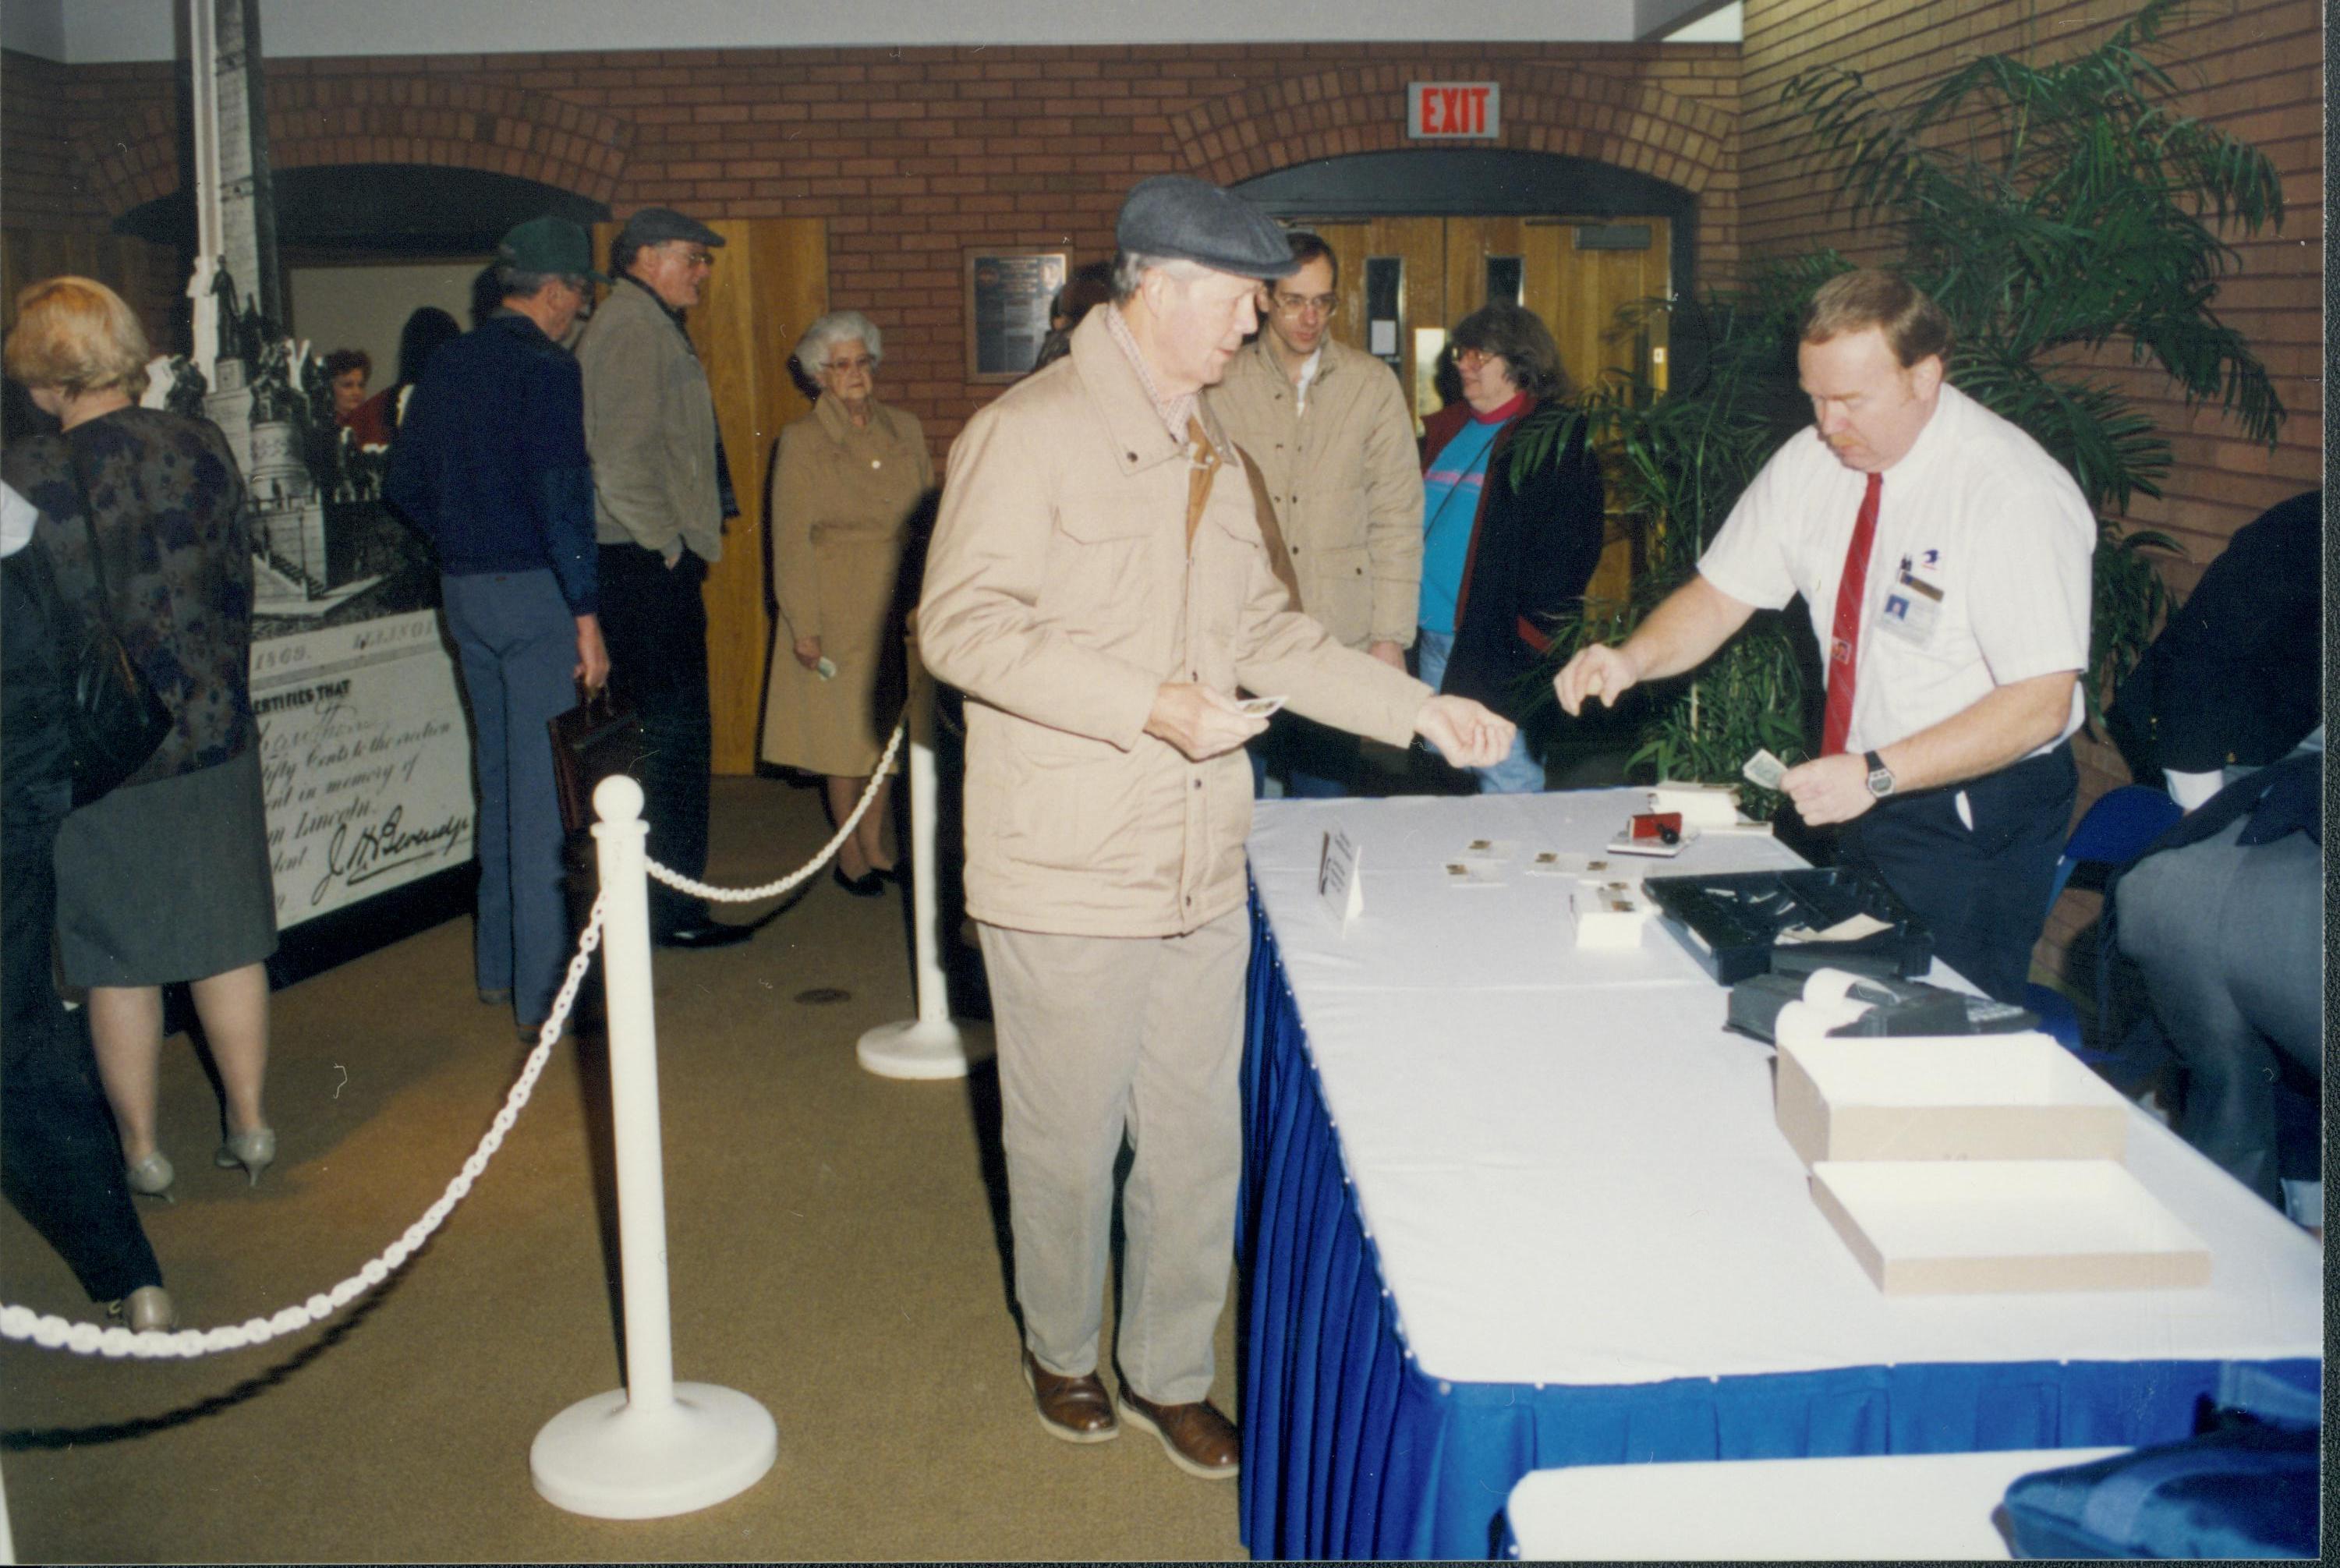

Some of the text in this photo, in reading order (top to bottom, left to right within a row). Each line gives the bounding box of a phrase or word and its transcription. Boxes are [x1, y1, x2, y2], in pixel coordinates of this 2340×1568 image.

[1421, 87, 1490, 134] EXIT
[352, 621, 434, 650] ILLINOI
[253, 679, 352, 715] ERTIFIES THAT
[299, 787, 317, 802] in
[325, 763, 393, 796] memory
